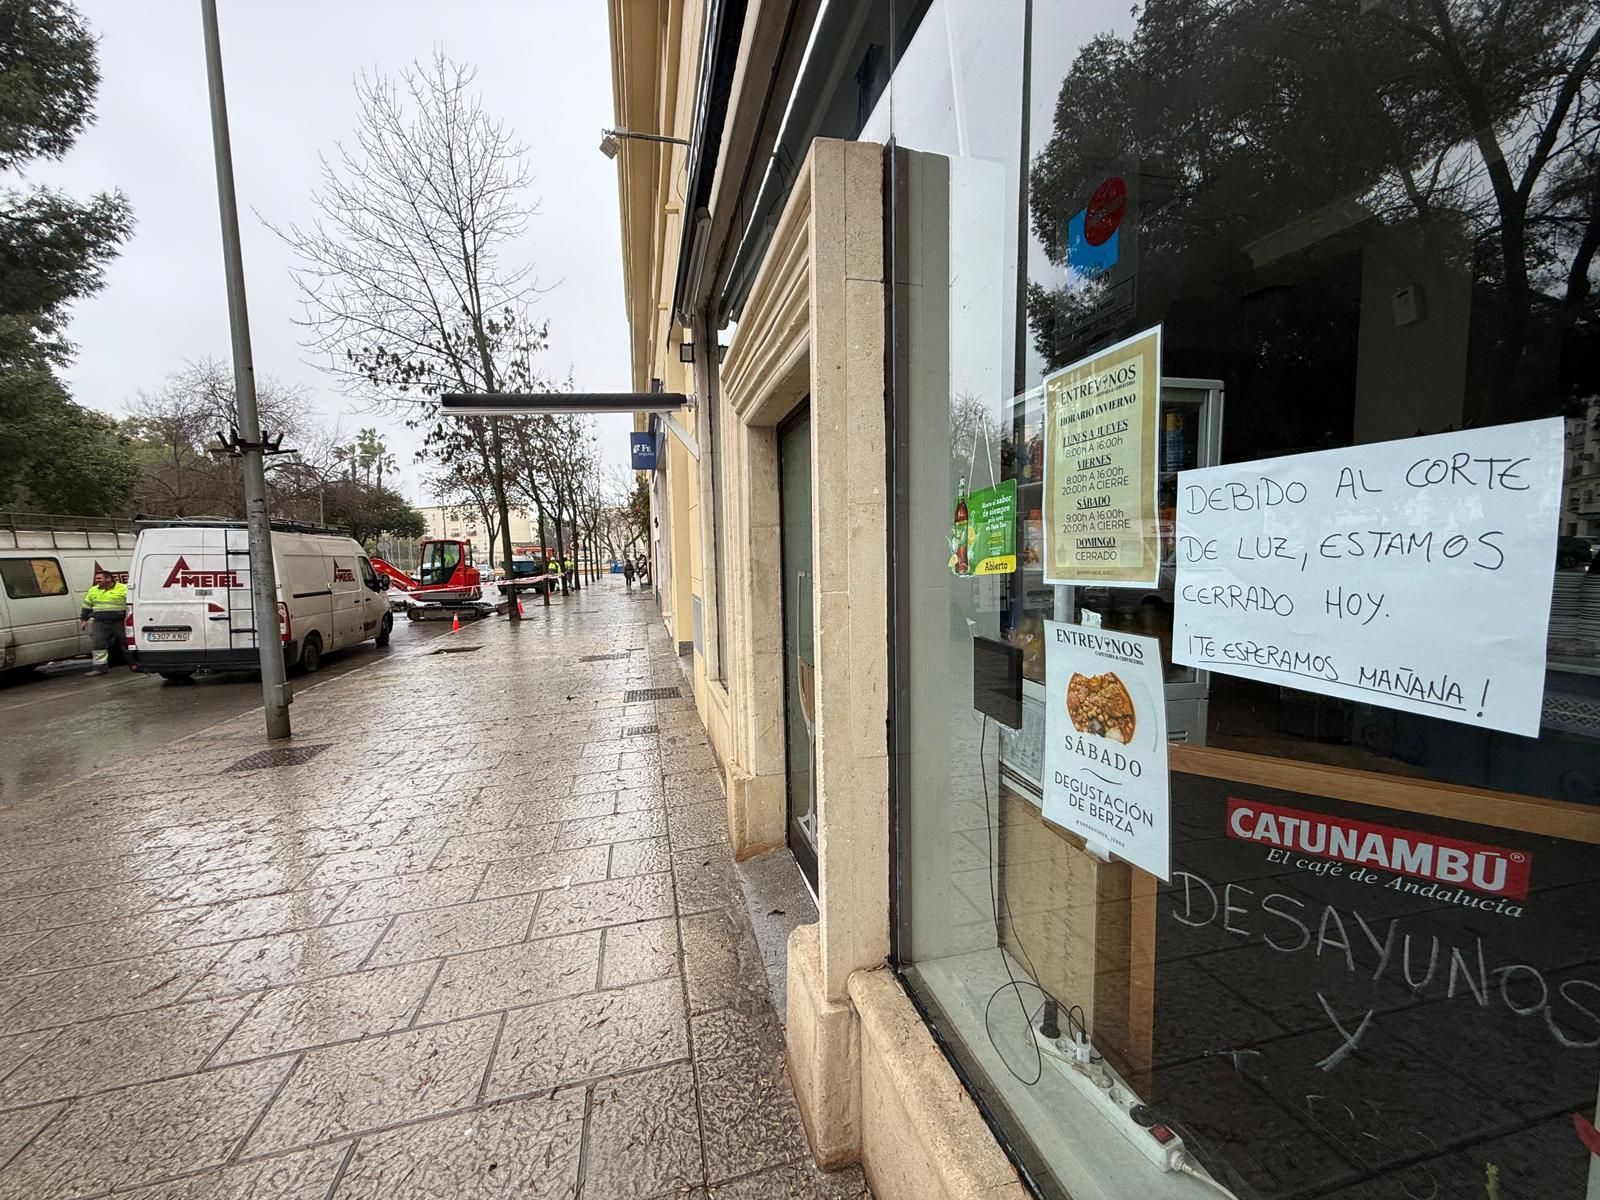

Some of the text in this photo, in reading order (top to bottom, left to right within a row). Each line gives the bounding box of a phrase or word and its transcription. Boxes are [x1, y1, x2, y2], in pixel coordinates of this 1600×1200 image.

[1060, 393, 1136, 427] HORARIO INVIERNO
[1063, 419, 1128, 447] LUNES A JUEVES
[1088, 443, 1095, 452] A
[1066, 466, 1124, 485] 8:00h A 16:00h
[1077, 454, 1111, 471] VIERNES
[1062, 477, 1128, 496] 20:00h A CIERRE
[1186, 452, 1531, 515] DEBIDO AL CORTE
[1066, 508, 1124, 523] 9:00h A 16:00h
[1077, 495, 1111, 509] SÁBADO
[1063, 519, 1131, 534] 20:00h A CIERRE
[1076, 536, 1116, 548] DOMINGO
[985, 561, 1008, 571] Abierto
[1075, 551, 1117, 561] CERRADO
[1179, 530, 1505, 572] DE LUZ, ESTAMOS
[162, 555, 244, 588] AMETEL
[1182, 584, 1389, 625] CERRADO HOY.
[1222, 641, 1339, 681] ESPERAMOS
[1065, 735, 1142, 777] SÁBADO
[1055, 771, 1153, 828] DEGUSTACIÓN
[1069, 793, 1134, 836] DE BERZA
[1266, 847, 1525, 918] El café de Andalucía
[1172, 871, 1600, 1048] DESAYUNOS
[1314, 991, 1374, 1072] Y
